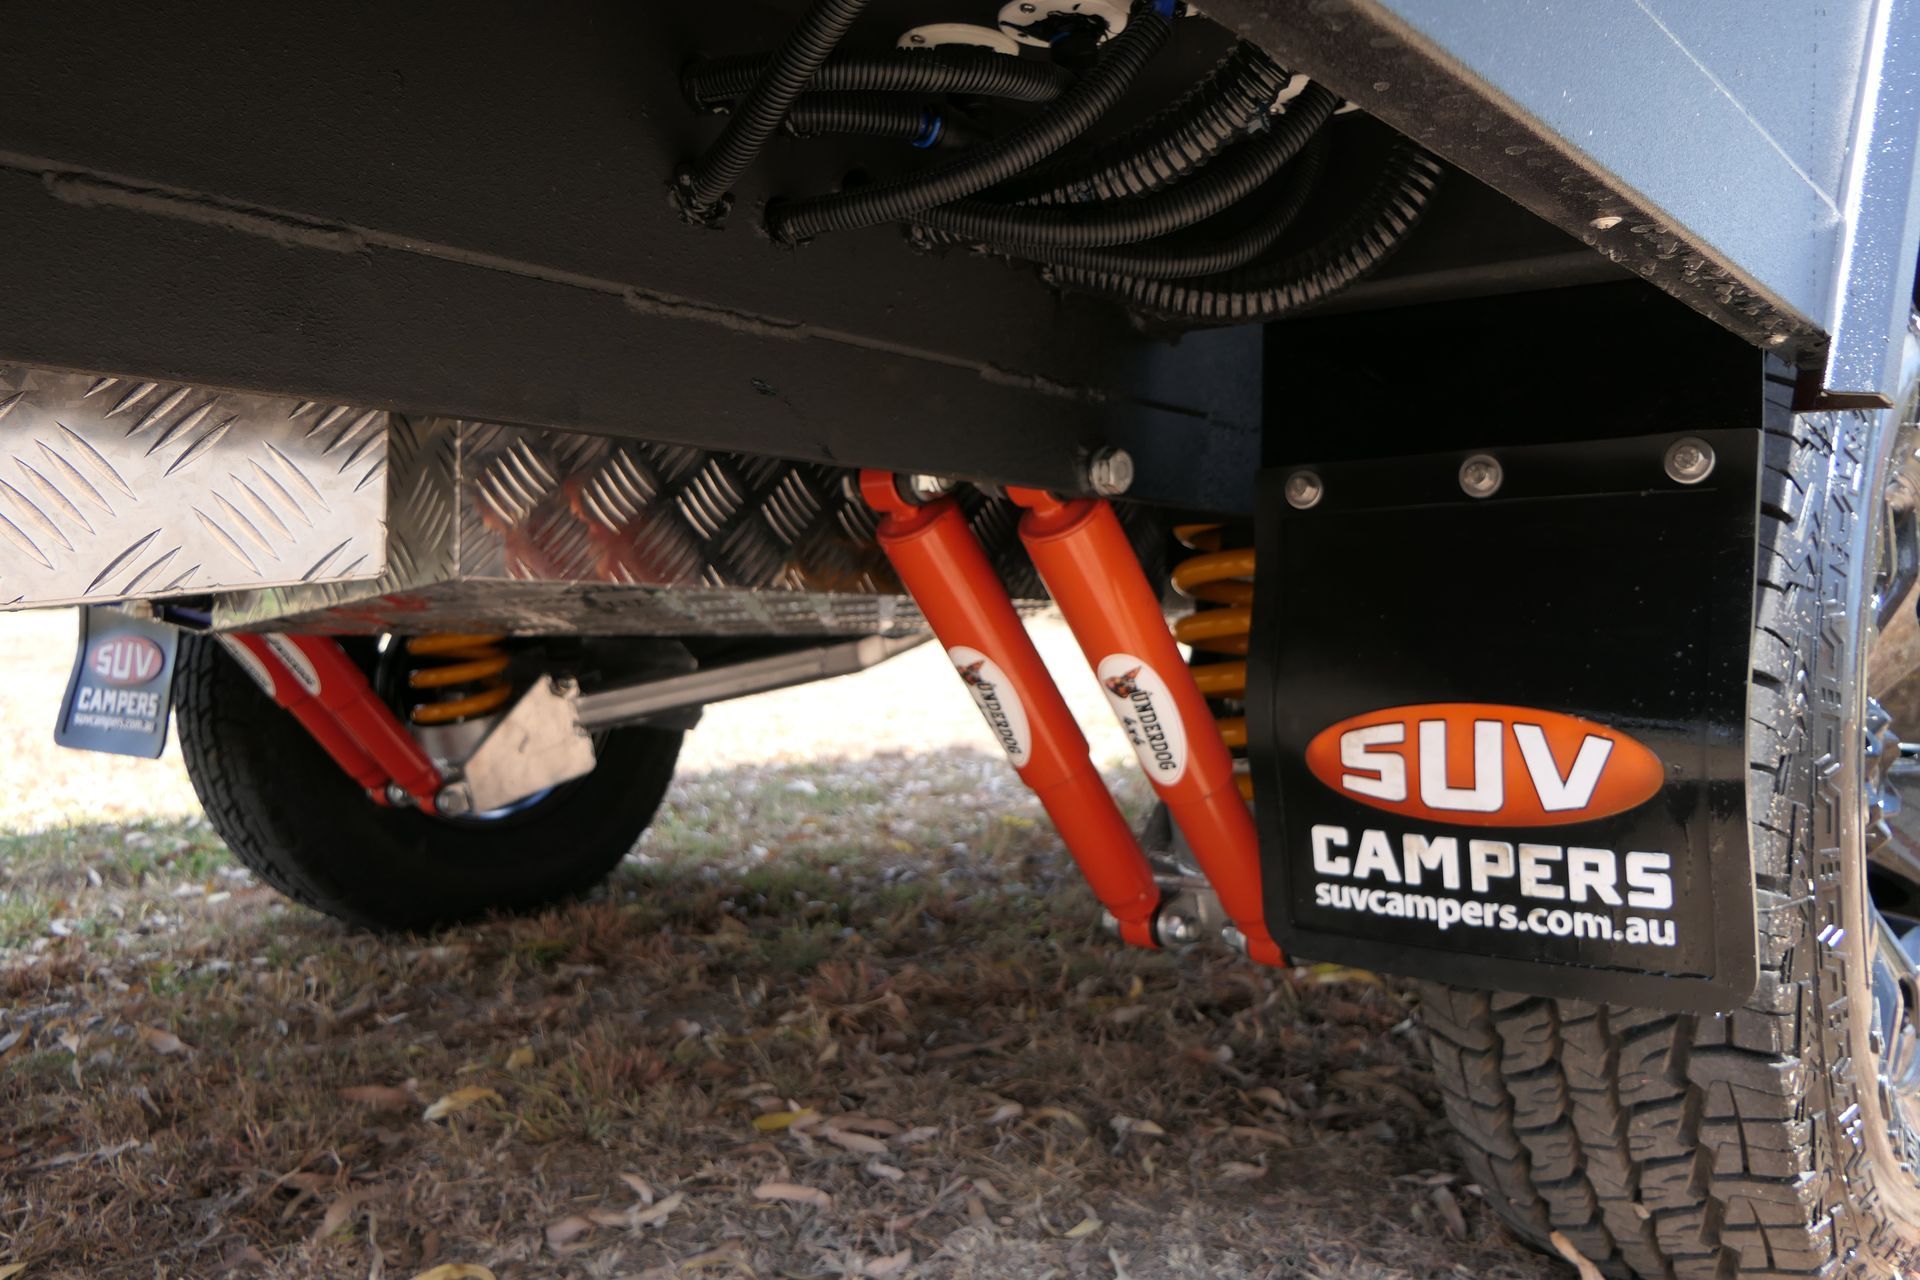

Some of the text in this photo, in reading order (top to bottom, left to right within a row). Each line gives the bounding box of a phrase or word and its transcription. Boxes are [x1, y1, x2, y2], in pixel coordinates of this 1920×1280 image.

[96, 640, 156, 679] SUV
[77, 686, 160, 718] CAMPERS
[976, 680, 1022, 755] UNDERDOG
[1130, 689, 1177, 771] UNDERDOG
[1339, 719, 1614, 813] SUV
[1311, 824, 1674, 910] CAMPERS
[1315, 881, 1676, 947] suvcampers.com.au
